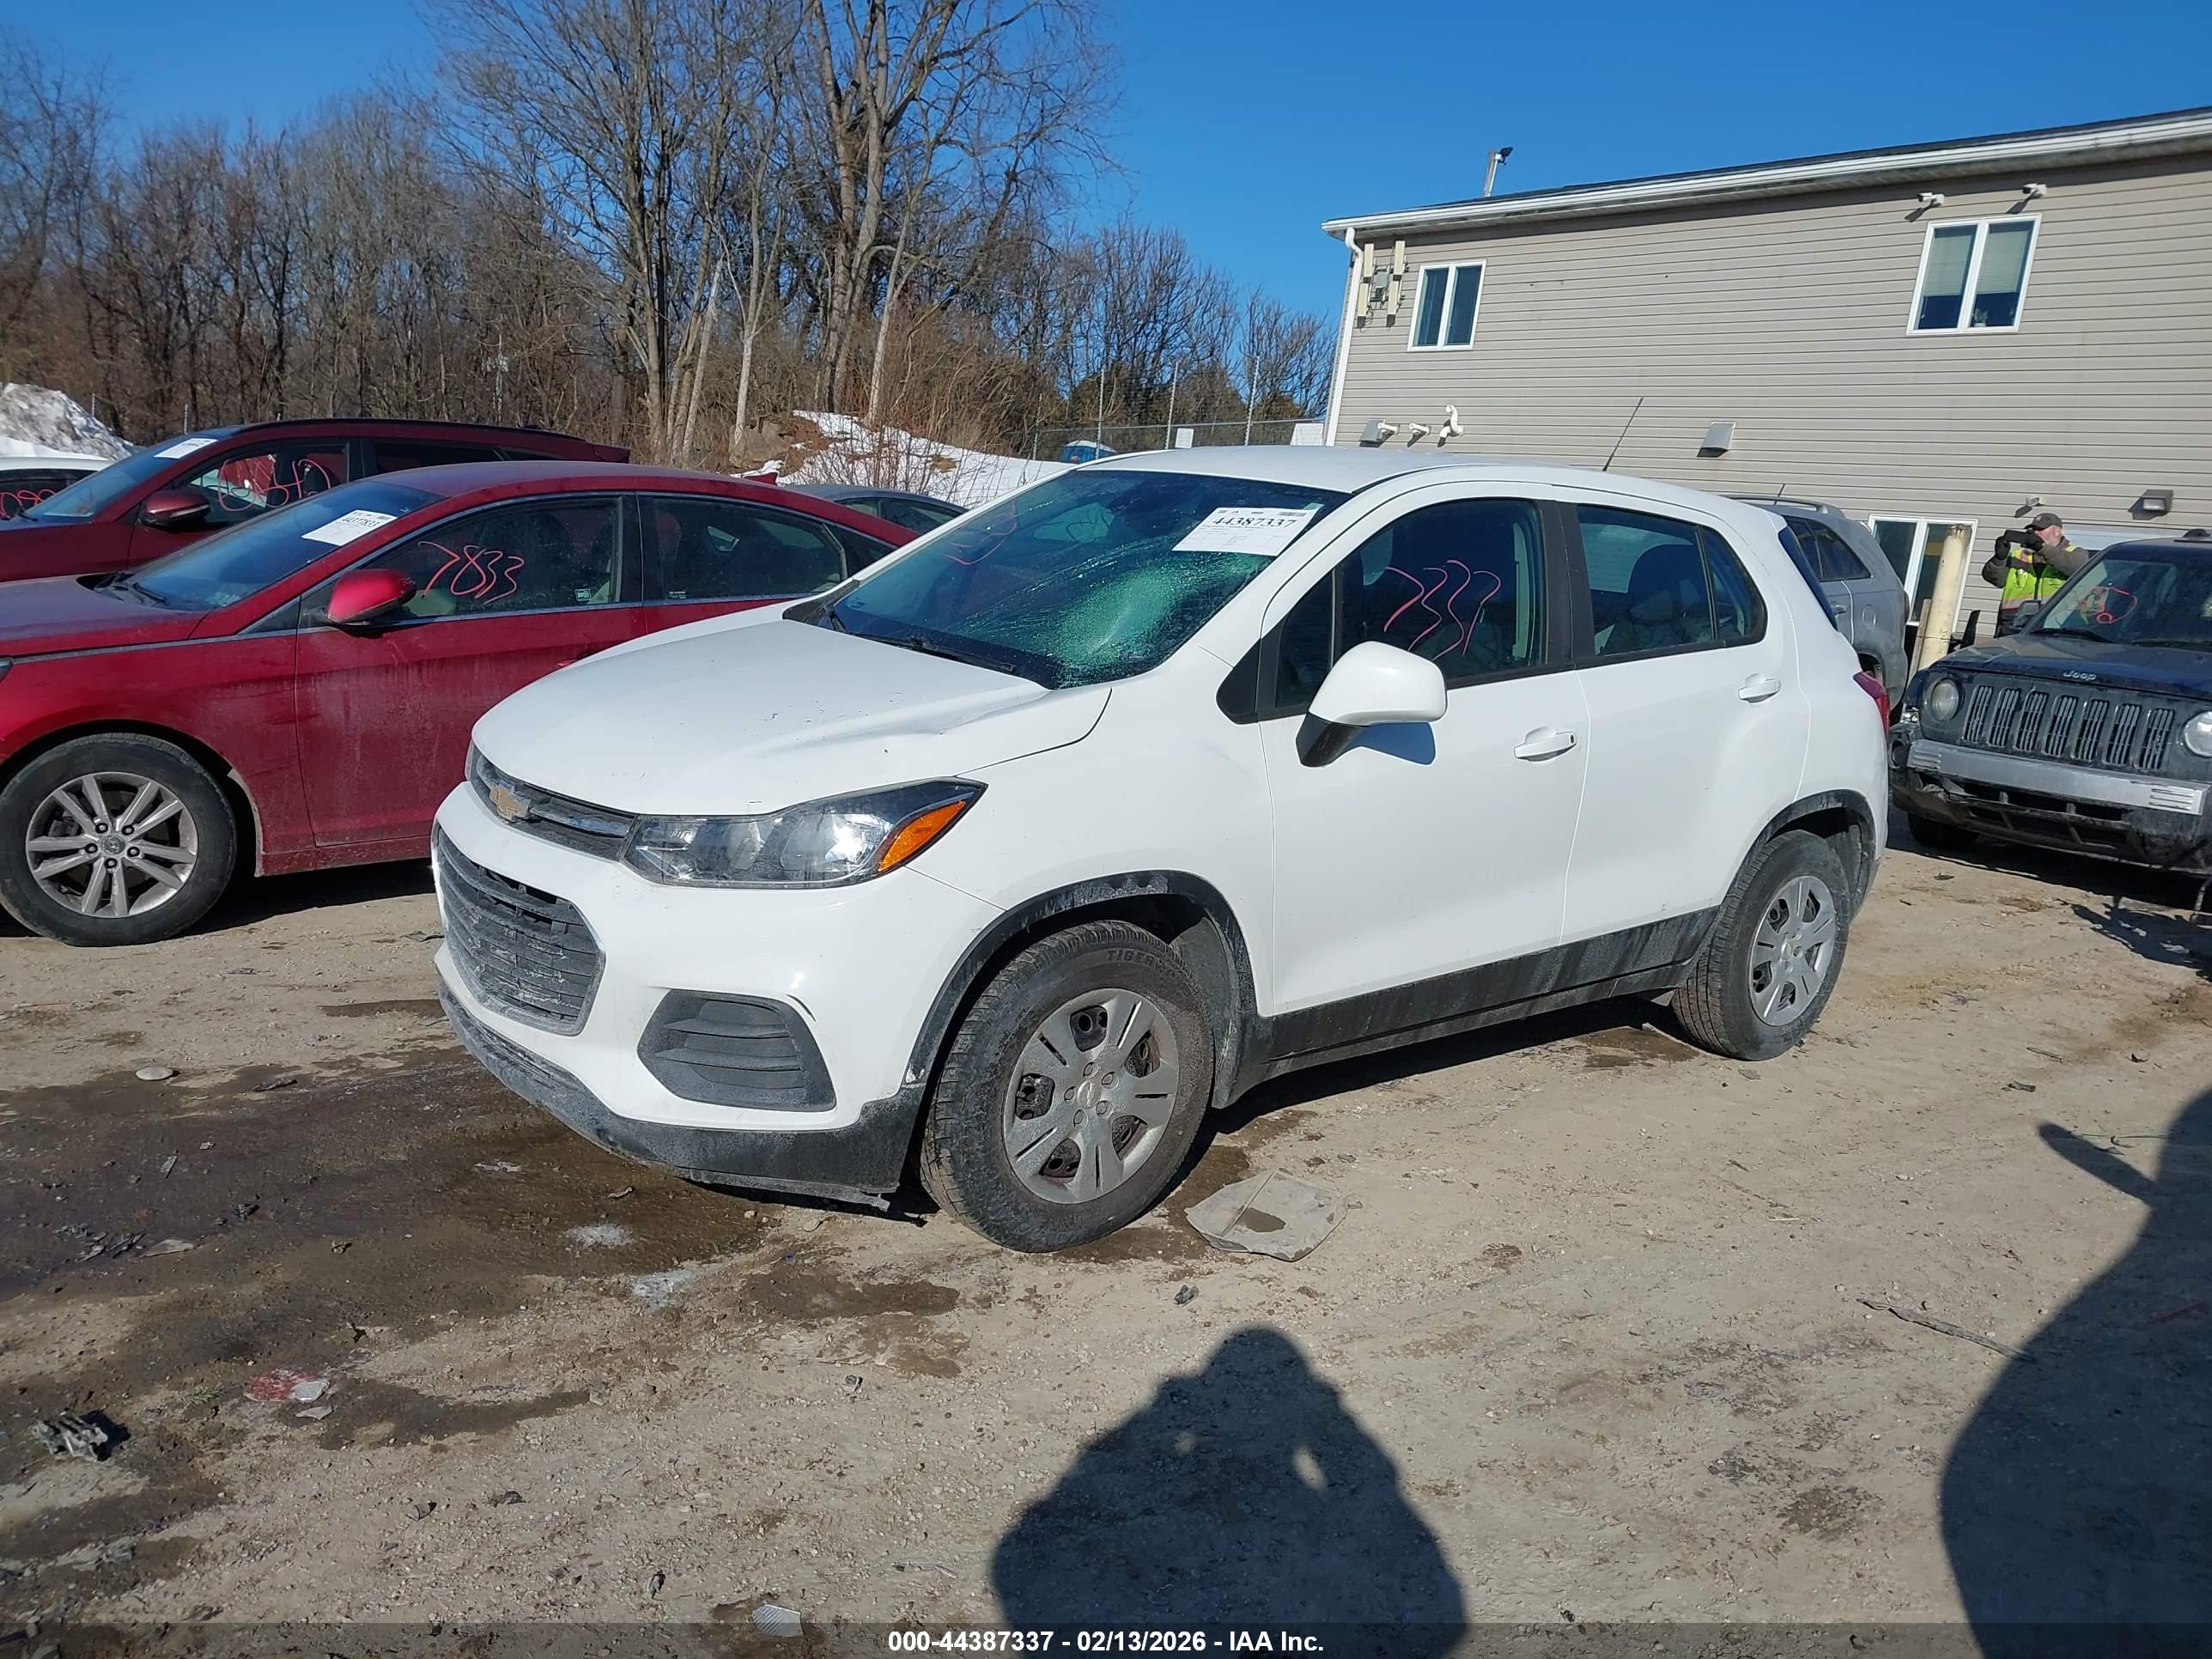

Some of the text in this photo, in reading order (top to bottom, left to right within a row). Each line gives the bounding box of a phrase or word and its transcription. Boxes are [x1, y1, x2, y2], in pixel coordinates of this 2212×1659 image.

[1212, 517, 1297, 527] 44387337
[417, 541, 526, 605] 7833
[1383, 559, 1502, 661] 7337
[2063, 670, 2097, 681] Jeep
